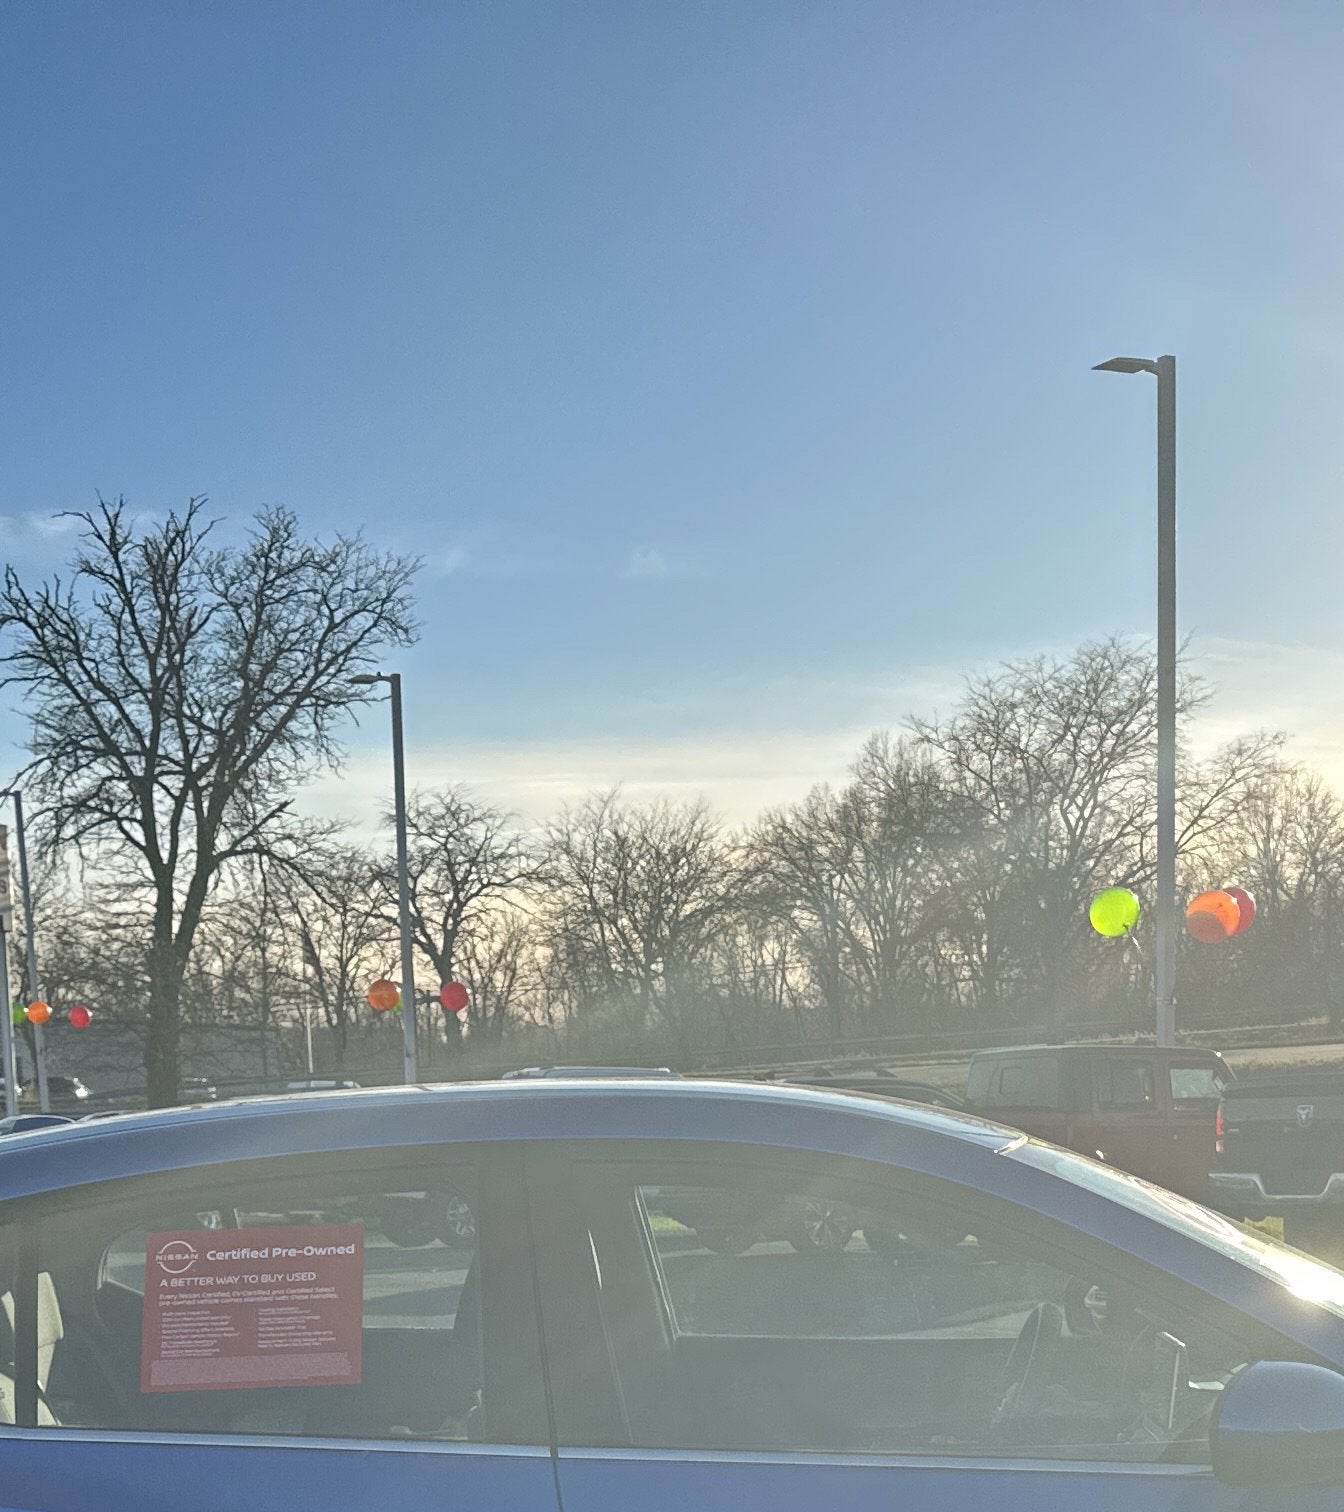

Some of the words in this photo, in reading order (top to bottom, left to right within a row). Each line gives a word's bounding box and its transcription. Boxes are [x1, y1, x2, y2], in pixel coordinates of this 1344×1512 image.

[156, 1253, 199, 1261] NISSAN
[206, 1247, 269, 1261] Certified
[272, 1243, 355, 1258] Pre-Owned
[160, 1279, 168, 1287] A
[170, 1276, 214, 1287] BETTER
[216, 1275, 240, 1285] WAY
[242, 1274, 258, 1284] TO
[261, 1273, 285, 1283] BUY
[286, 1271, 317, 1282] USED
